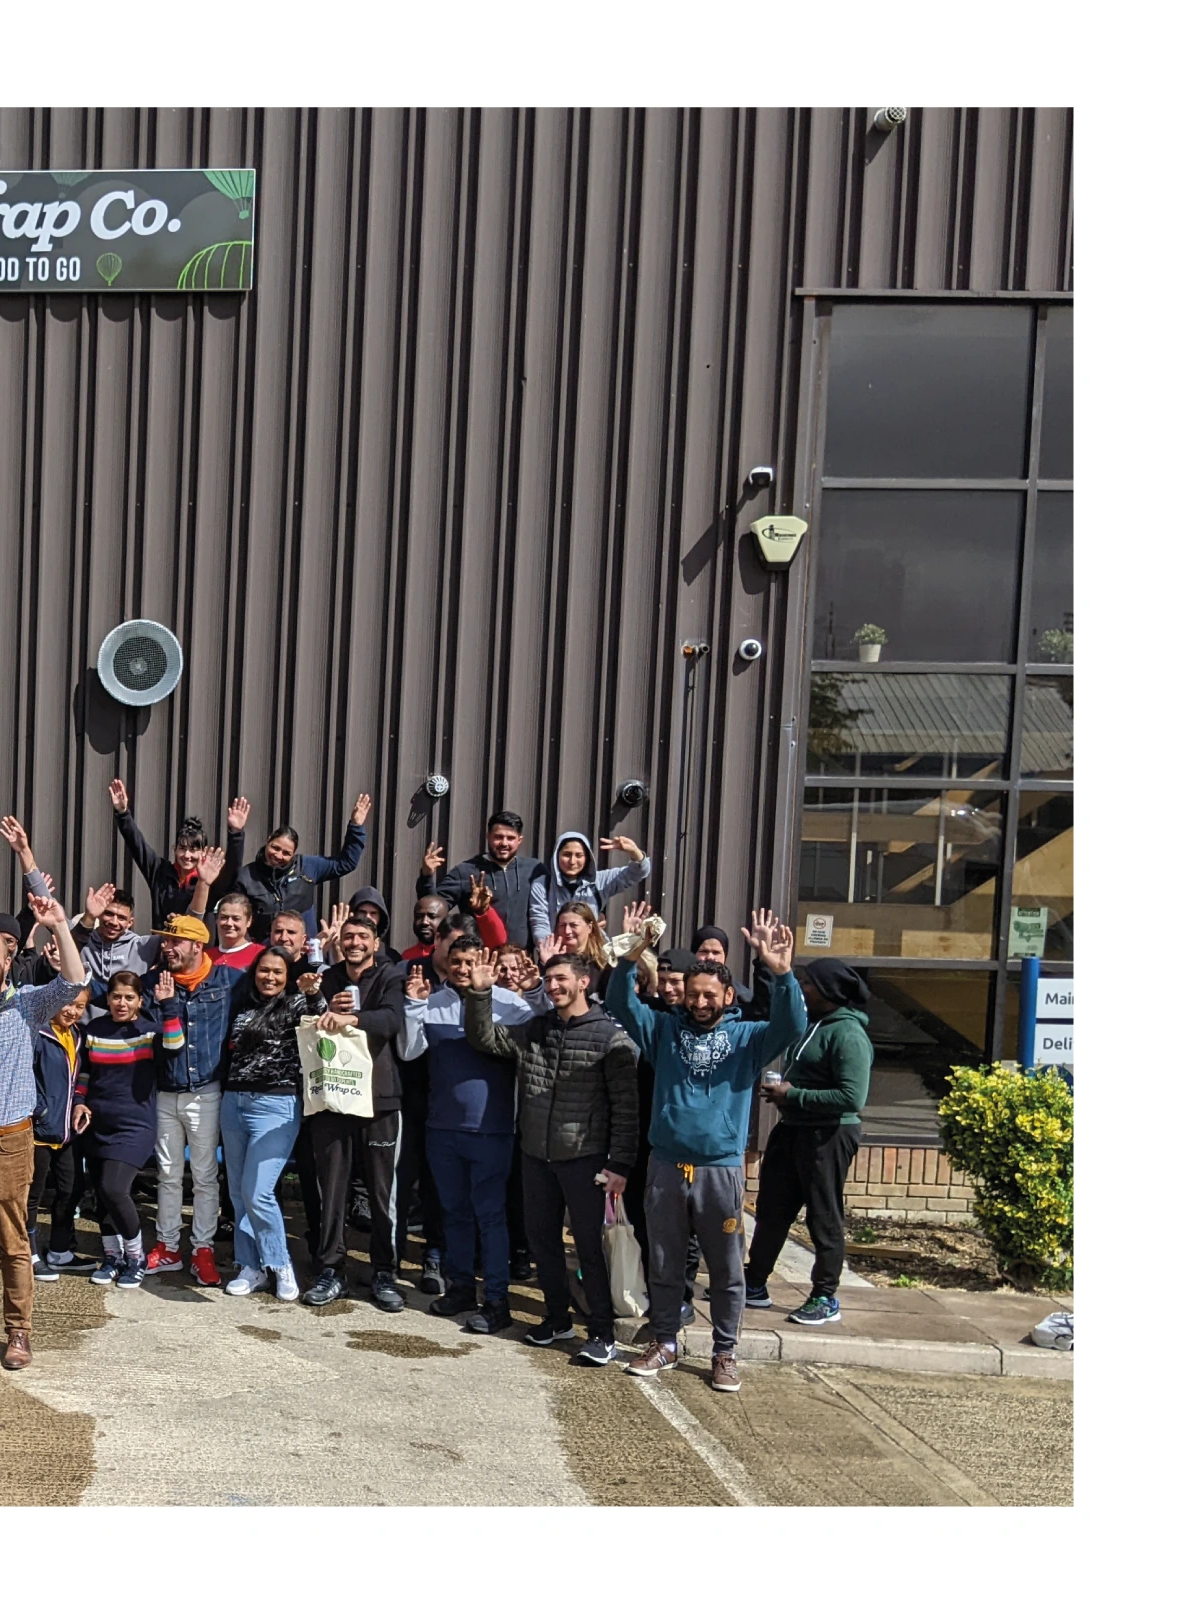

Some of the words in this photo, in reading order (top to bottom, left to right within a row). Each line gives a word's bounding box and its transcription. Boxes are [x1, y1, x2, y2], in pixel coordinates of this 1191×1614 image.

[90, 190, 181, 240] Co.
[26, 257, 49, 281] TO
[56, 257, 81, 281] GO
[1045, 992, 1074, 1005] Mai
[1043, 1037, 1074, 1050] Deli
[324, 1083, 349, 1095] Wrap
[350, 1088, 362, 1096] Co.
